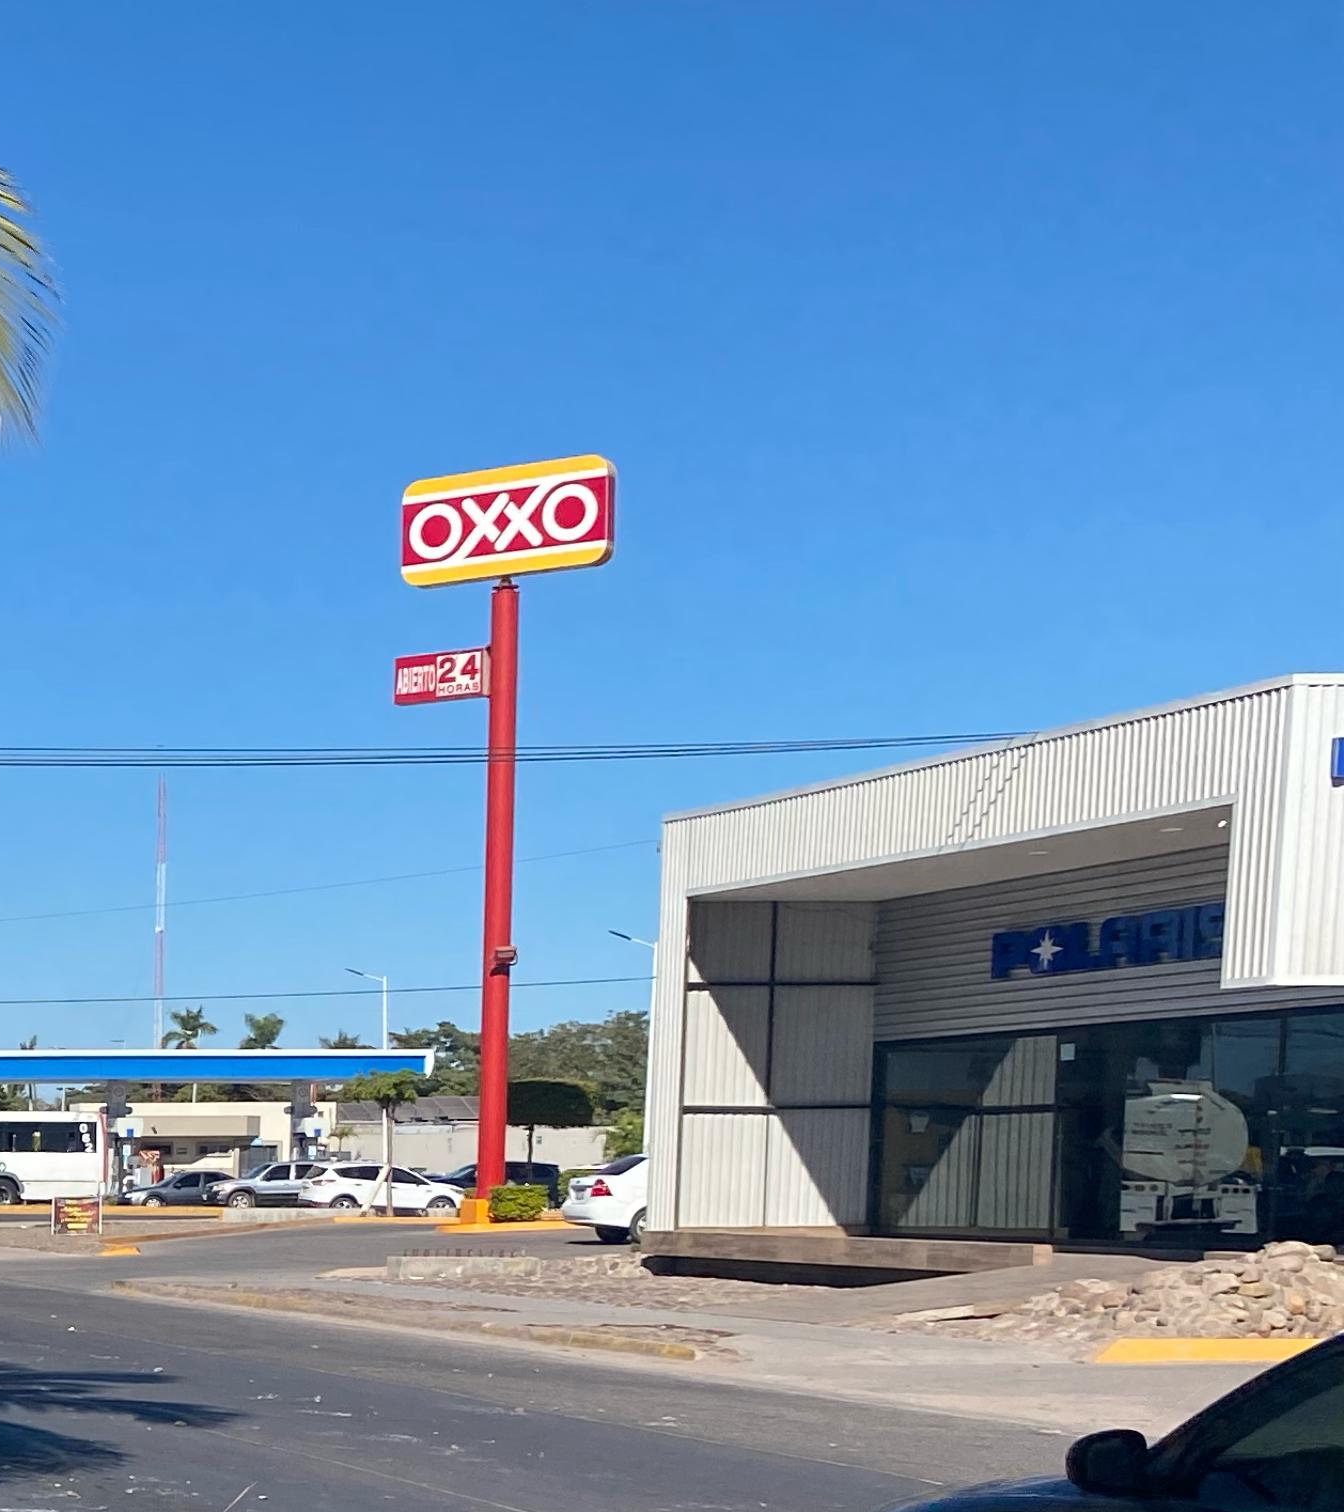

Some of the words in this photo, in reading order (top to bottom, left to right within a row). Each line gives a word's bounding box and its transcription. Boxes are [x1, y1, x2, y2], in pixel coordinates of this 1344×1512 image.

[409, 484, 598, 559] OXXO
[396, 664, 436, 695] ABIERTO
[438, 654, 479, 684] 24
[438, 681, 480, 694] HORAS
